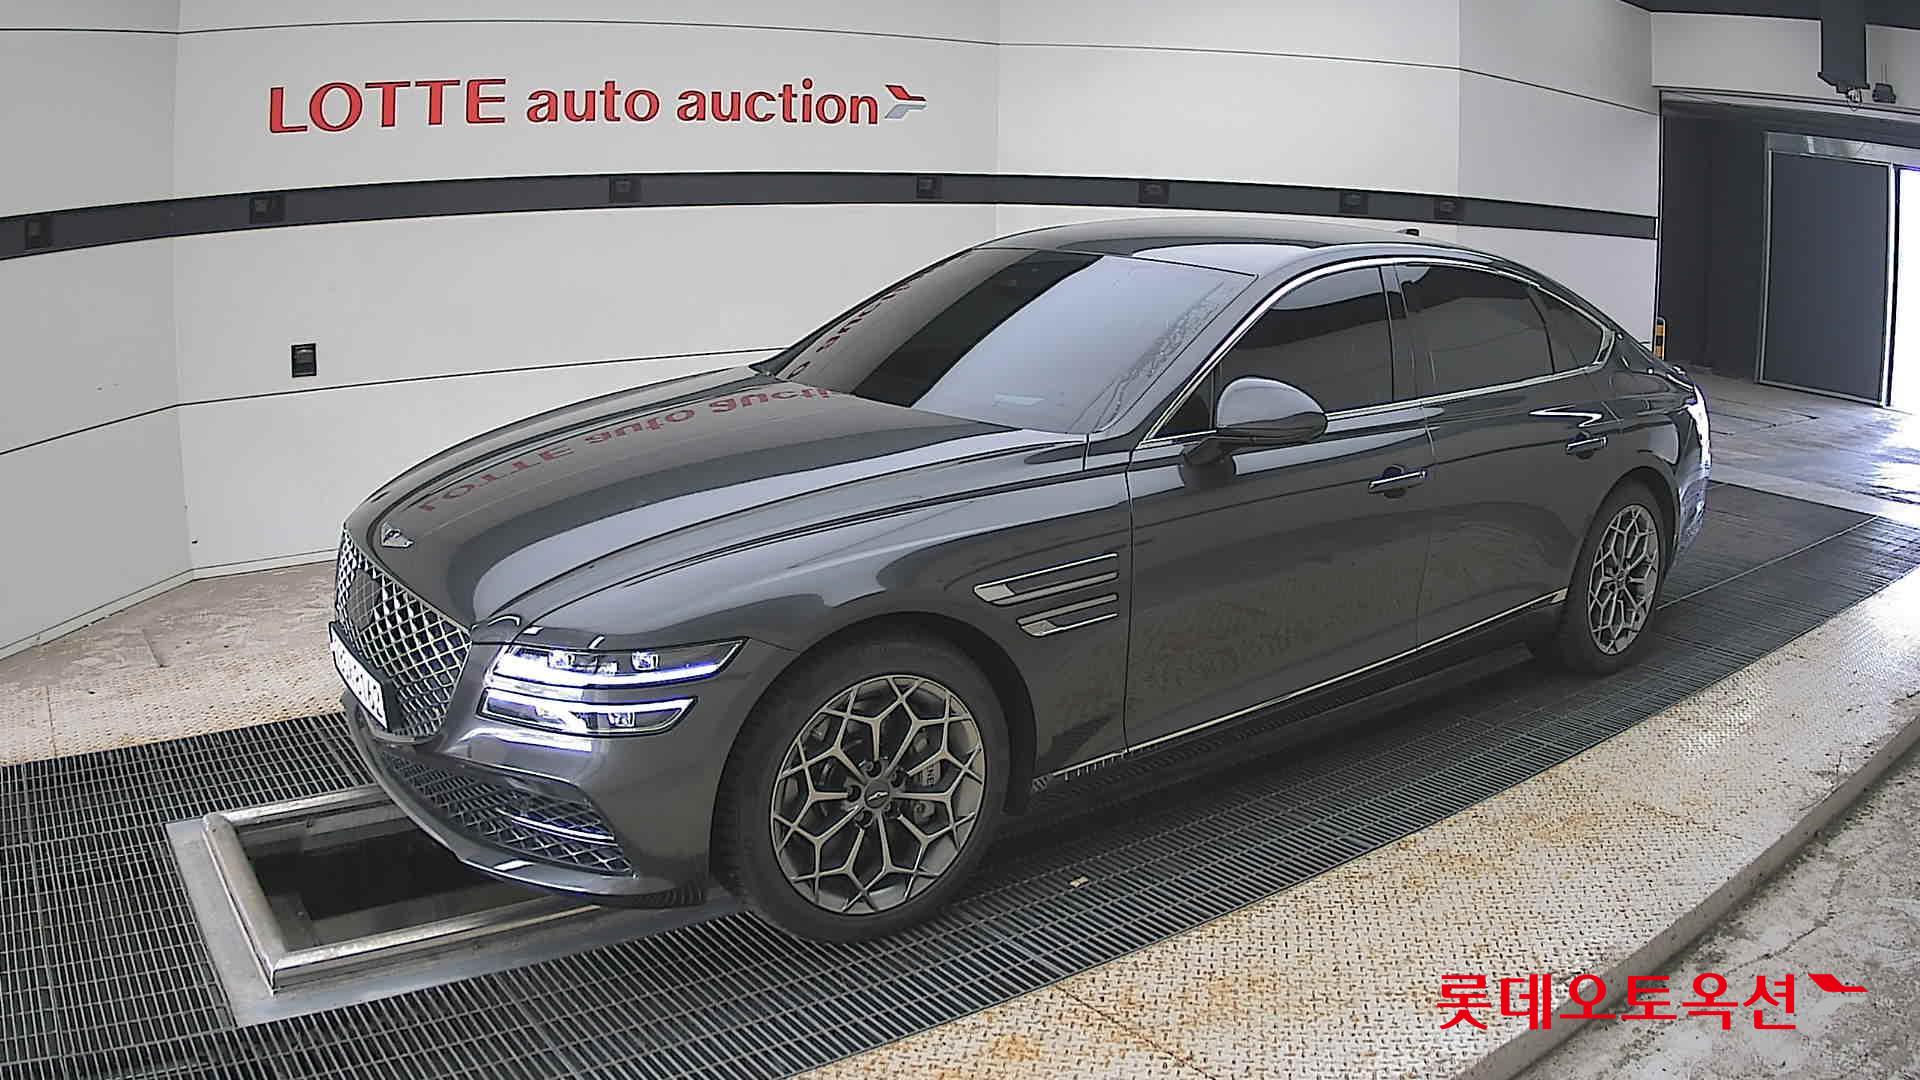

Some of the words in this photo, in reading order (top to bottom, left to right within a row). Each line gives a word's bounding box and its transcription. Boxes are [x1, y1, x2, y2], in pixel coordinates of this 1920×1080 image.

[269, 78, 506, 134] LOTTE
[526, 80, 660, 122] auto
[676, 78, 878, 125] auction
